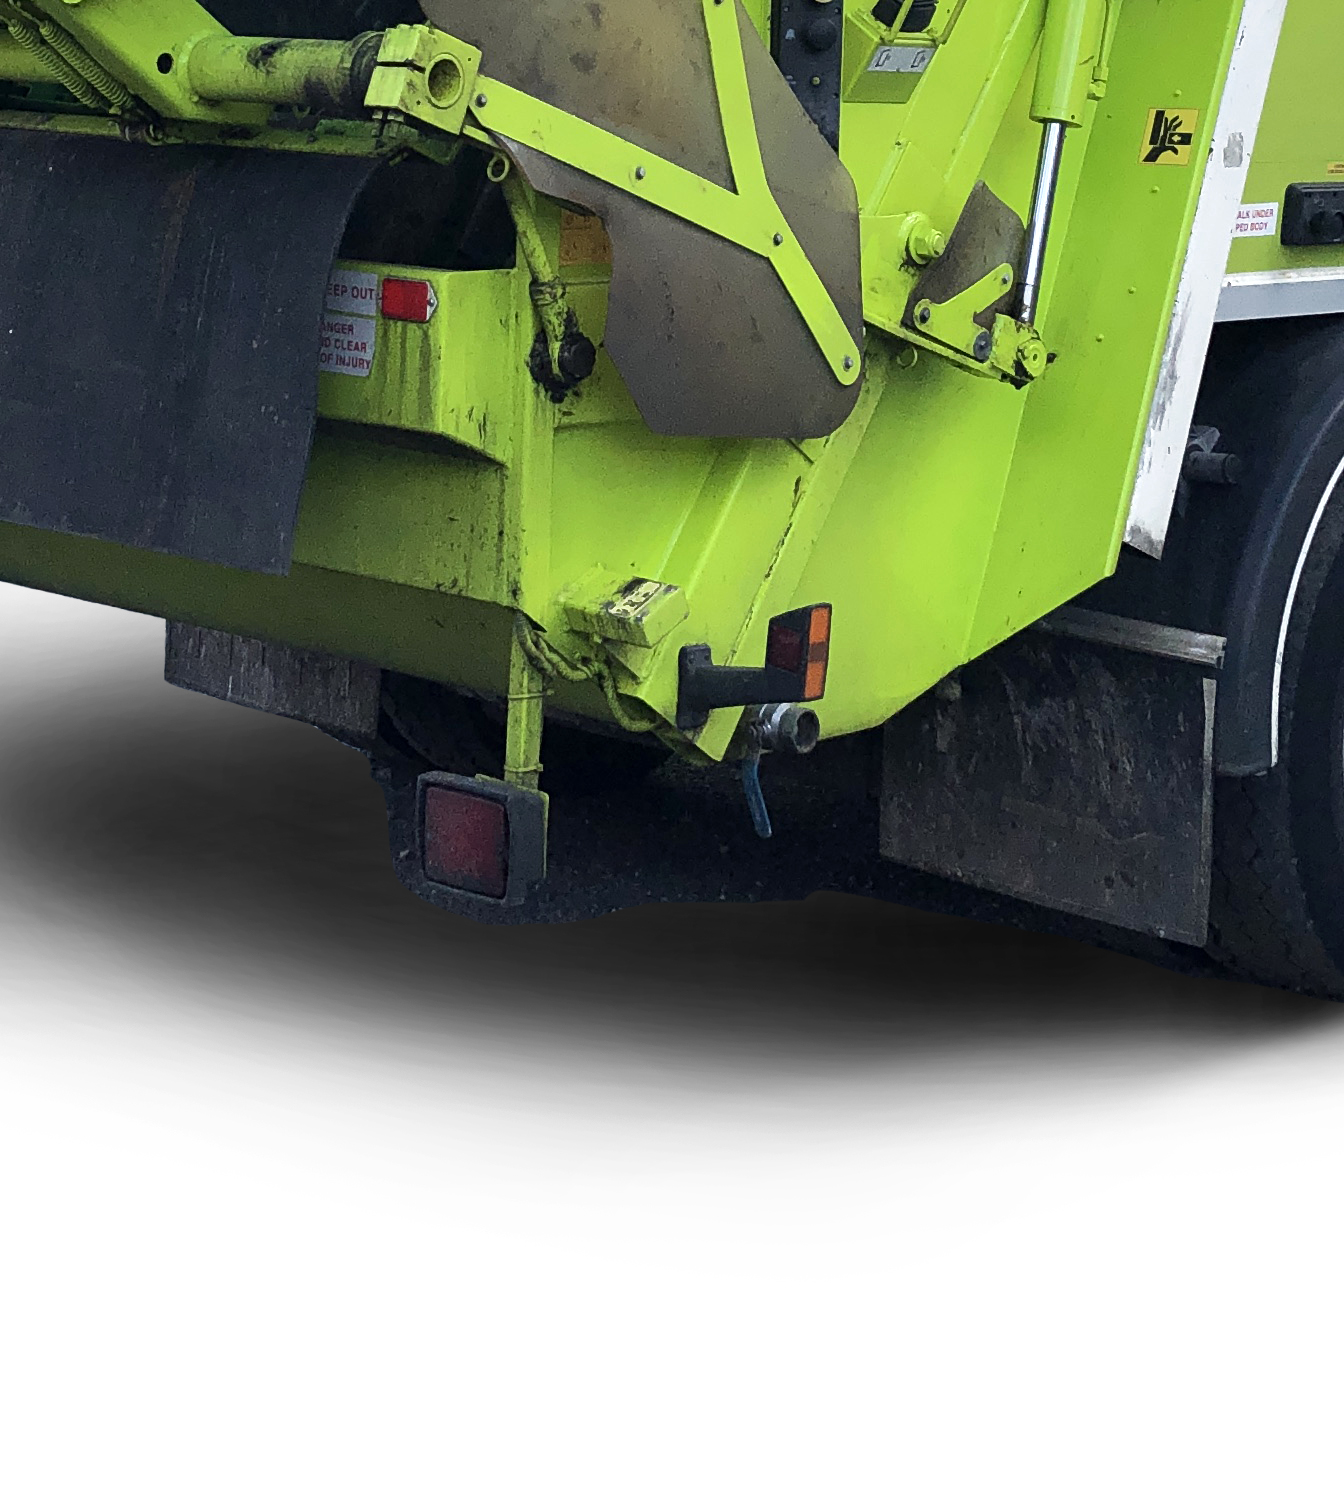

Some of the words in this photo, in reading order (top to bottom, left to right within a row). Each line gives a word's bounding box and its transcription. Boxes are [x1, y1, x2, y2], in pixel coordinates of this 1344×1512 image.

[351, 285, 375, 300] OUT
[319, 321, 354, 335] ANGER
[334, 339, 367, 353] CLEAR
[335, 353, 371, 369] INJURY
